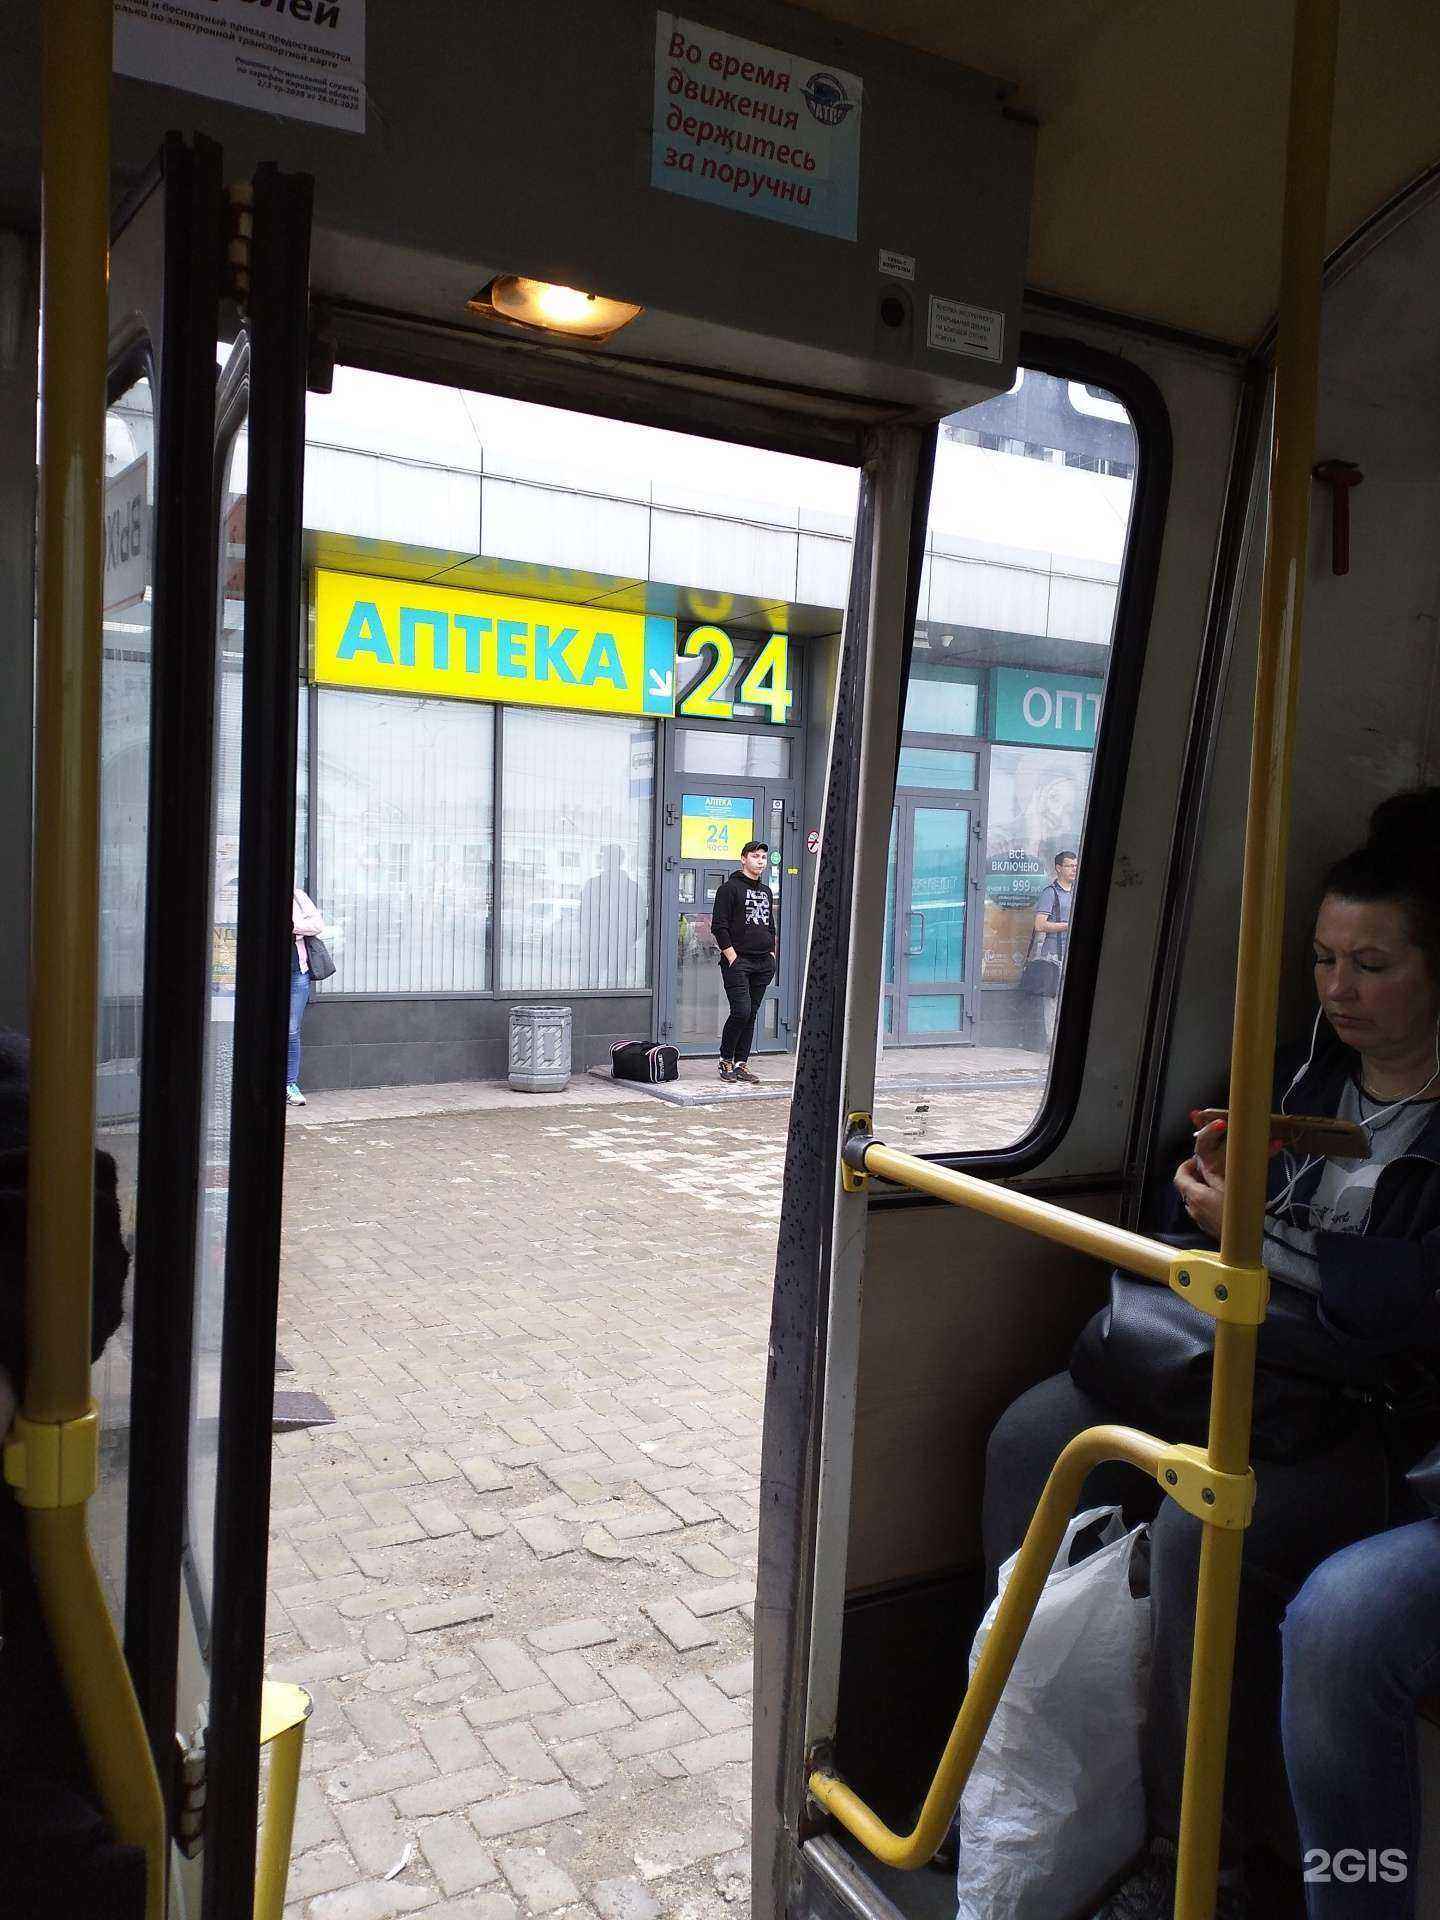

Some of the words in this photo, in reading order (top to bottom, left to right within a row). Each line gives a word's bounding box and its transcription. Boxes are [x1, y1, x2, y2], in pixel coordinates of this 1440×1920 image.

[113, 3, 148, 18] олько
[668, 31, 702, 64] Во
[709, 51, 792, 93] время
[667, 66, 799, 130] движения
[666, 102, 816, 171] держитесь
[663, 146, 695, 173] за
[701, 157, 812, 206] поручни
[335, 600, 629, 690] АПТЕКА
[679, 624, 793, 725] 24
[708, 824, 729, 844] 24
[991, 861, 1040, 872] ВКЛЮЧЕНО
[1012, 879, 1031, 892] 999
